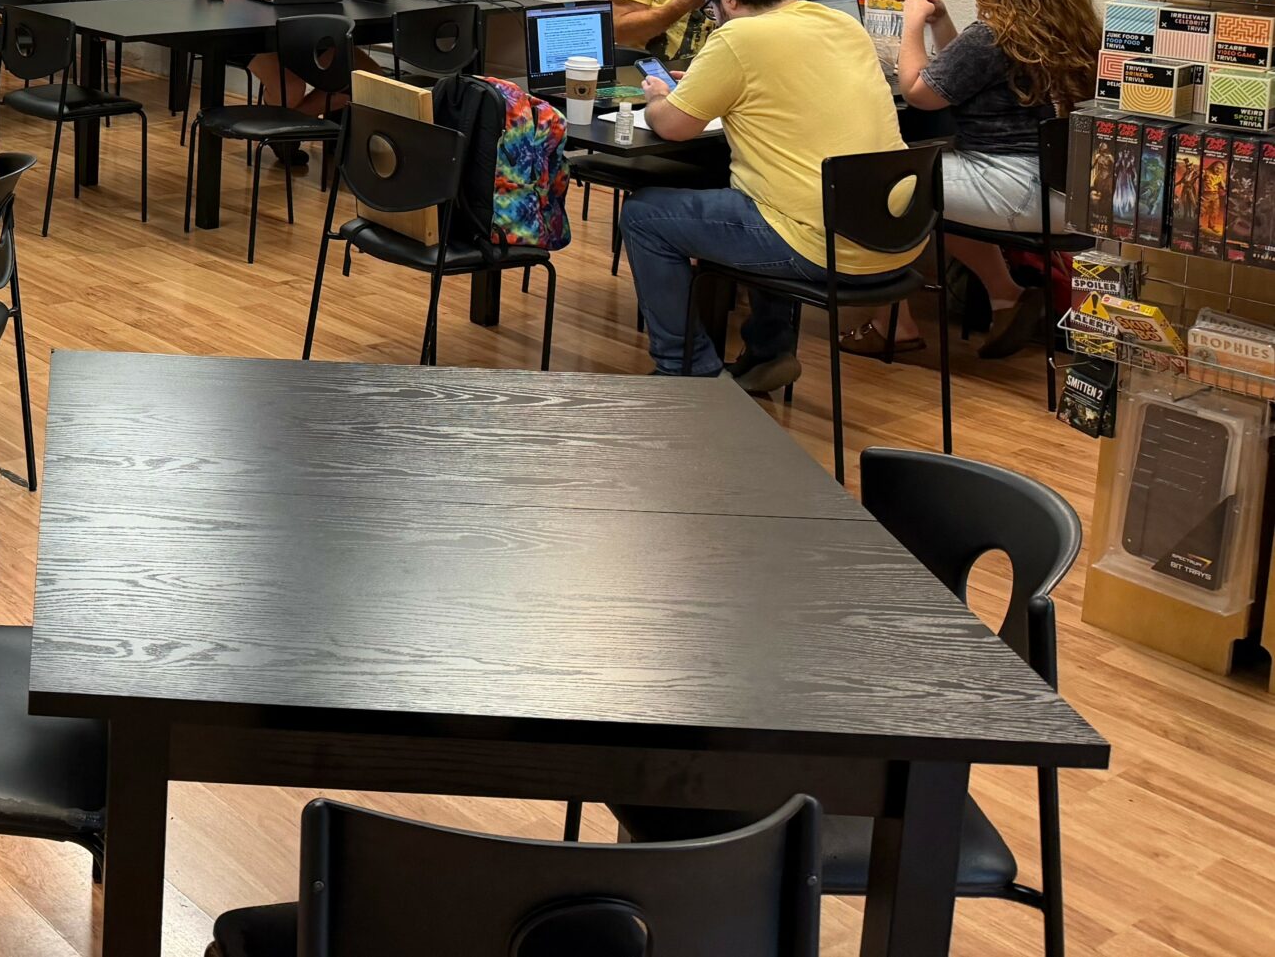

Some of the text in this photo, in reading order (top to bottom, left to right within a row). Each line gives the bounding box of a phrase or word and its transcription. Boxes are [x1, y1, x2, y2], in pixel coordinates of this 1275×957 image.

[1171, 12, 1209, 21] IRRELEVANT
[1175, 19, 1209, 27] CELEBRITY
[1217, 44, 1247, 52] BIZARRE
[1235, 51, 1256, 59] GAME
[1125, 65, 1148, 73] TRIVIAL
[1125, 71, 1154, 79] DRINKING
[1240, 108, 1263, 116] WEIRD
[1233, 114, 1263, 122] SPORTS
[1239, 119, 1263, 128] TRIVIA
[1074, 279, 1117, 292] SPOILER
[1074, 313, 1116, 333] ALERT!
[1138, 329, 1163, 342] BO
[1191, 332, 1270, 360] TROPHIES
[1066, 374, 1104, 401] SMITTEN 2
[1171, 552, 1203, 568] SPECTRUM
[1170, 562, 1213, 582] BIT TRAYS
